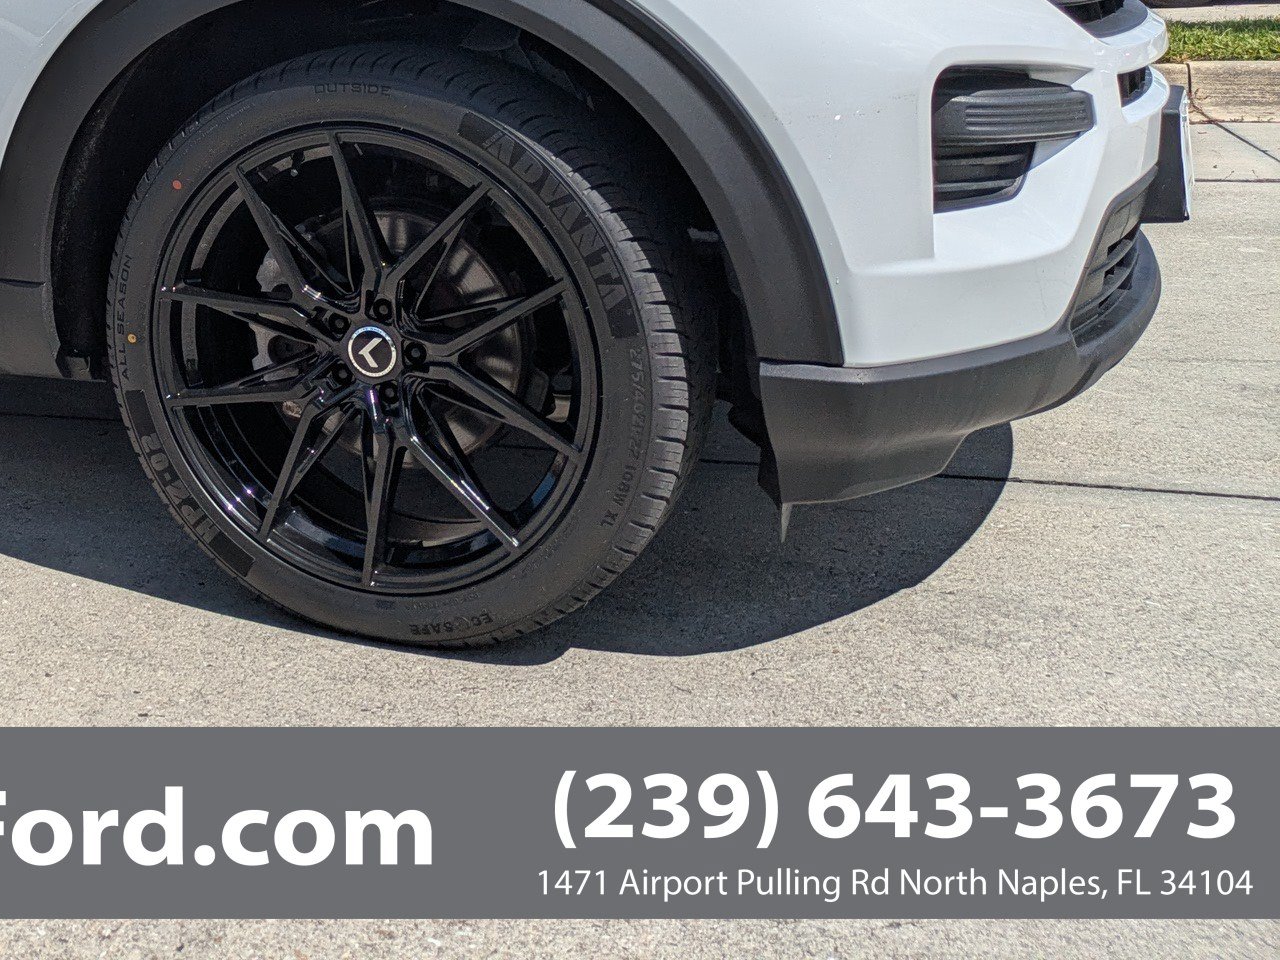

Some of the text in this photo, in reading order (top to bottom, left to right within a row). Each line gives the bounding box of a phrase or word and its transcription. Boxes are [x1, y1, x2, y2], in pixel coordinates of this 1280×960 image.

[314, 82, 392, 97] OUTSIDE
[484, 129, 628, 311] ADVANTA
[117, 254, 133, 382] ALL SEASON
